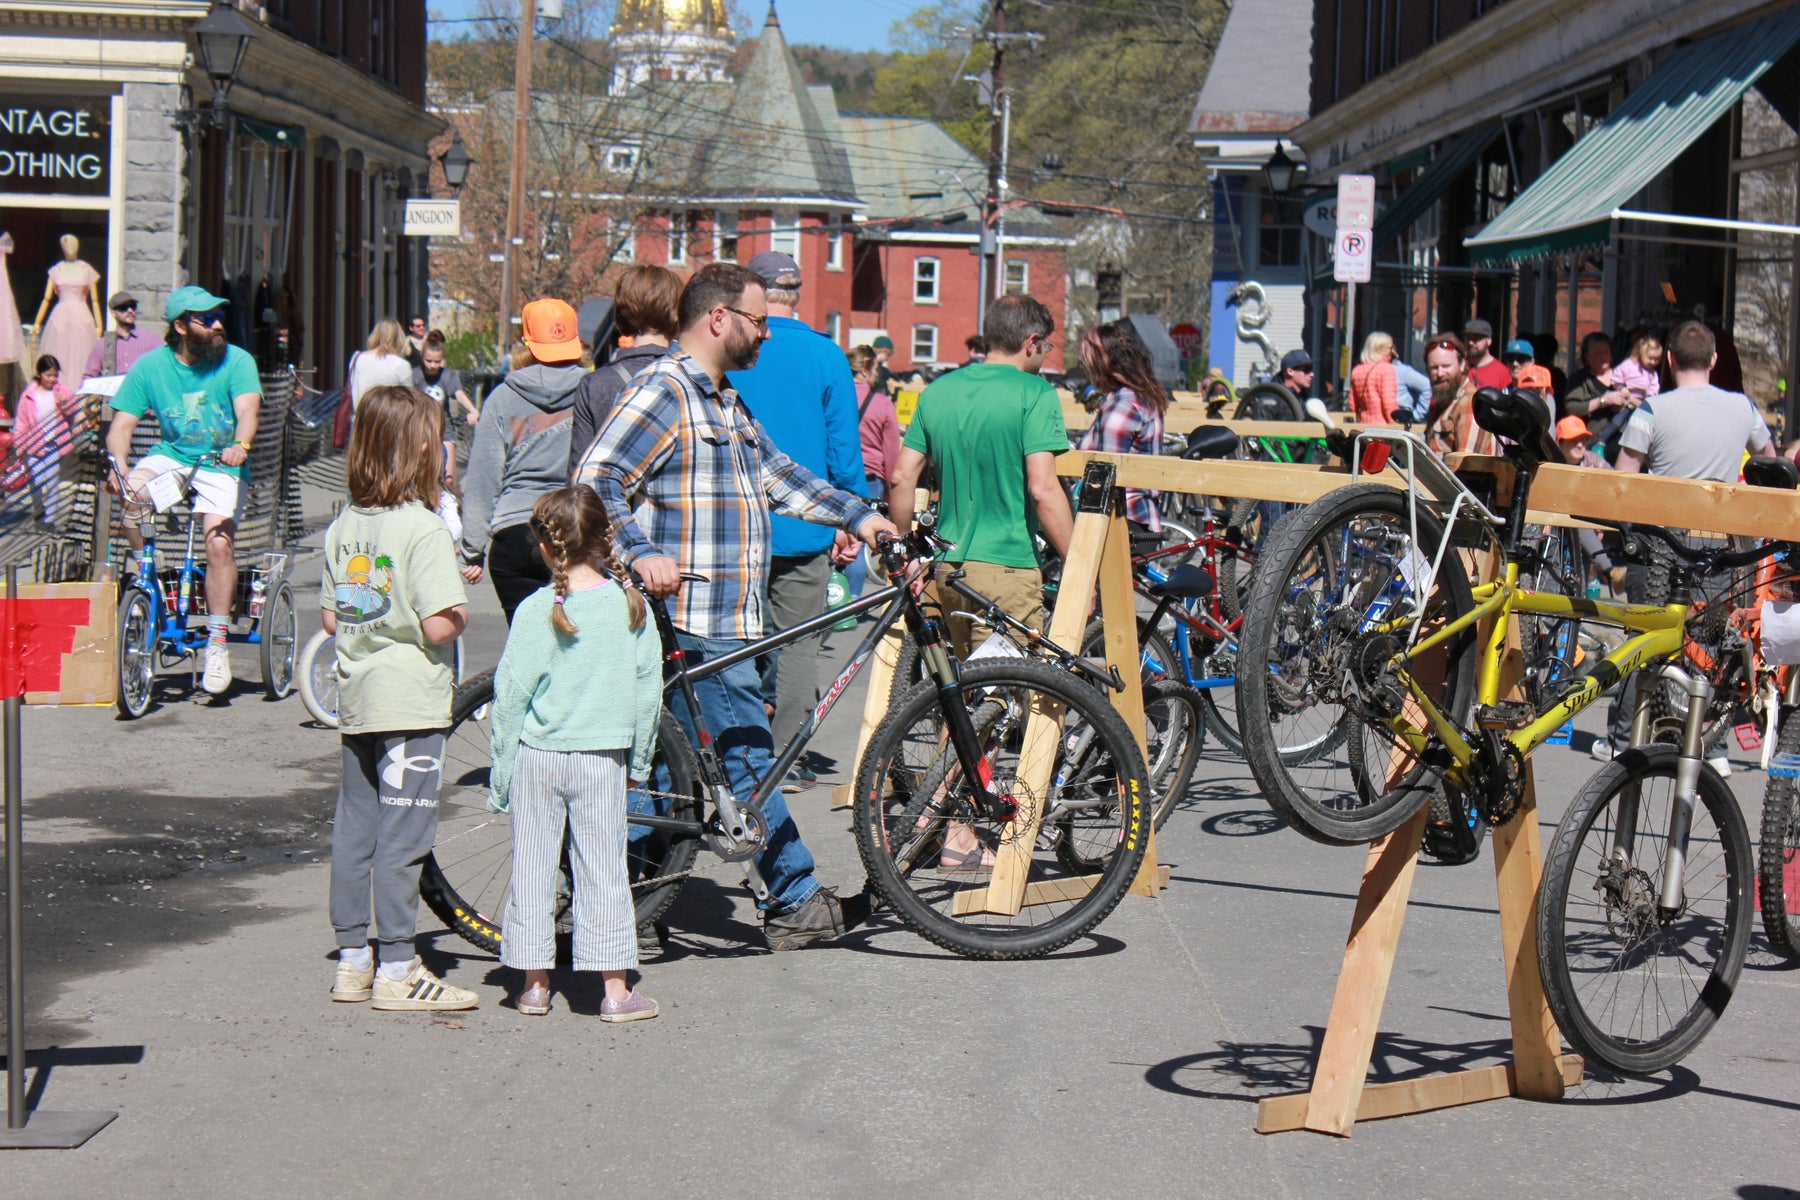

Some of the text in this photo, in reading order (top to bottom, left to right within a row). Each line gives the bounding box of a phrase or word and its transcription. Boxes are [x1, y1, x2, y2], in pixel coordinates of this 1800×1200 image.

[403, 209, 453, 224] LANGDON
[816, 661, 864, 720] Salsa
[1127, 779, 1141, 851] MAXXIS
[455, 908, 502, 942] AXXIS
